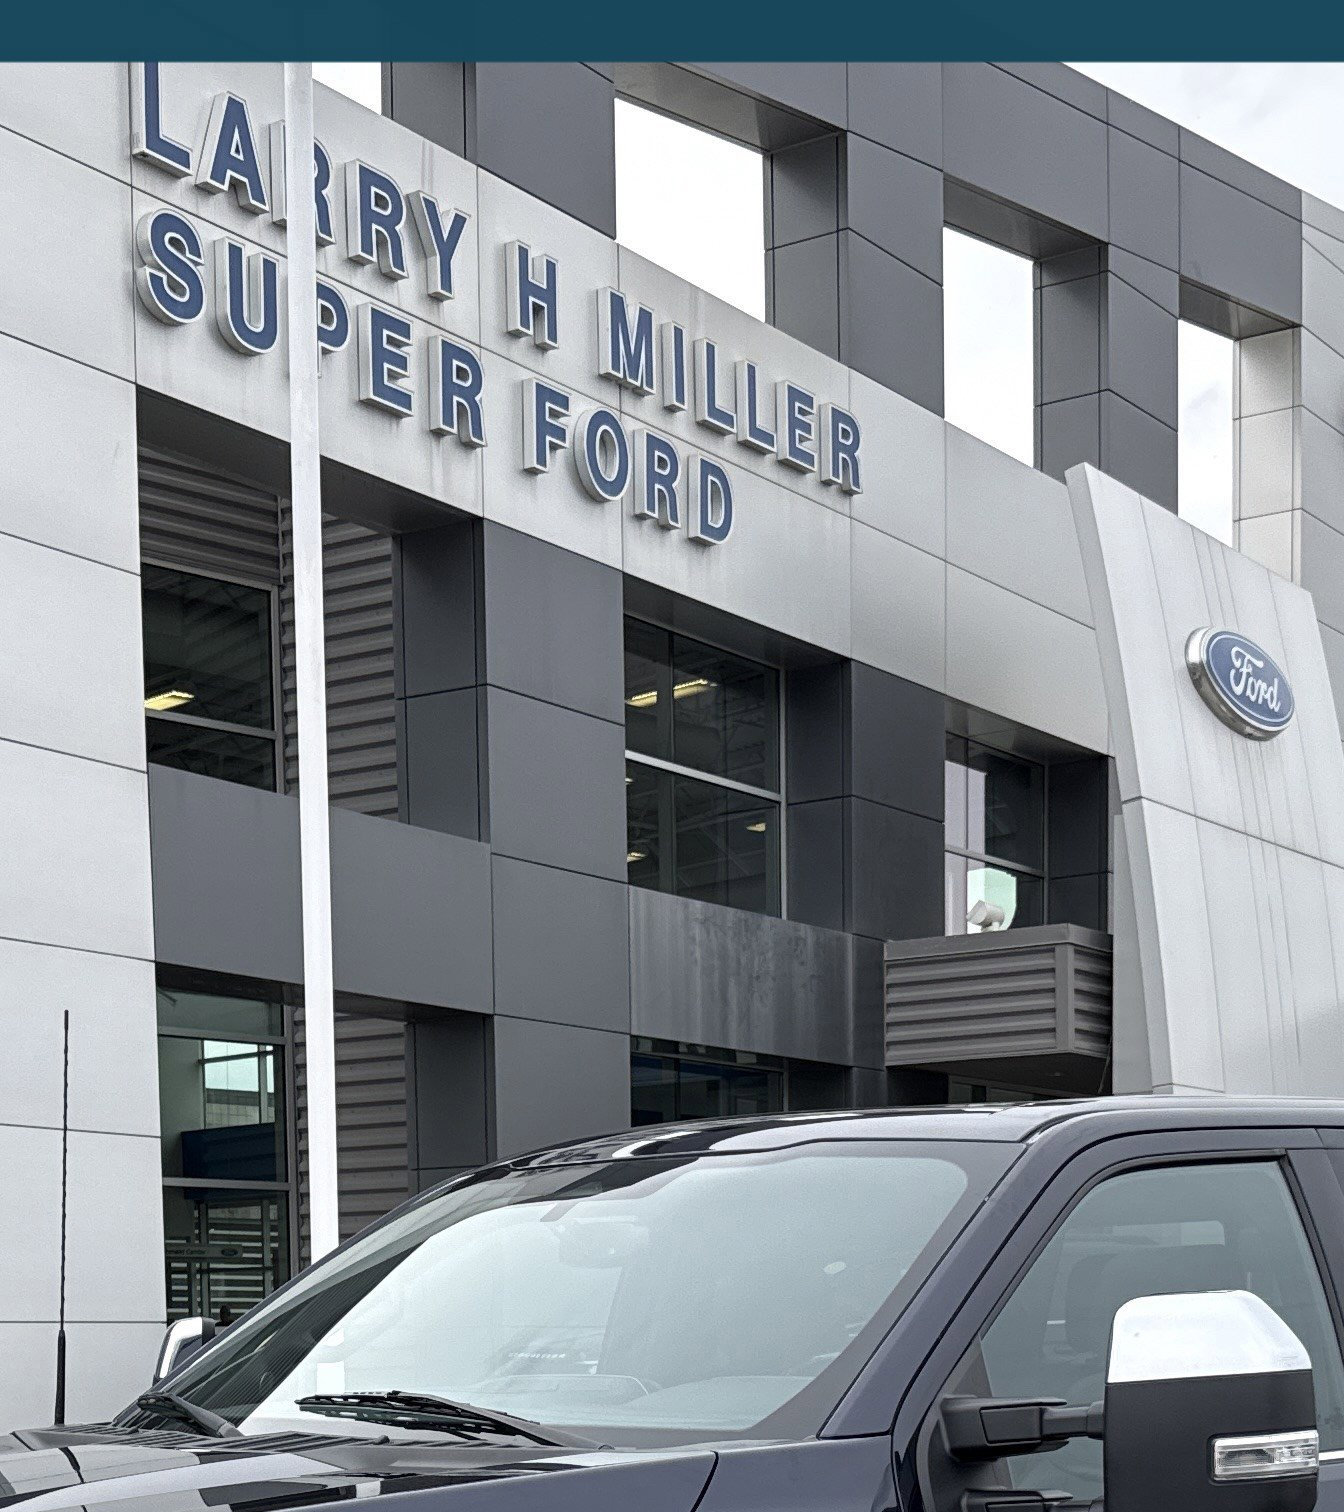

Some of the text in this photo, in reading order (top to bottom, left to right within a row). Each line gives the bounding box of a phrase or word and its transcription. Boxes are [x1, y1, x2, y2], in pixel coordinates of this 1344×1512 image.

[137, 208, 735, 547] SUPER FORD
[506, 239, 559, 351] H
[597, 286, 863, 496] MILLER
[1229, 645, 1281, 713] Ford
